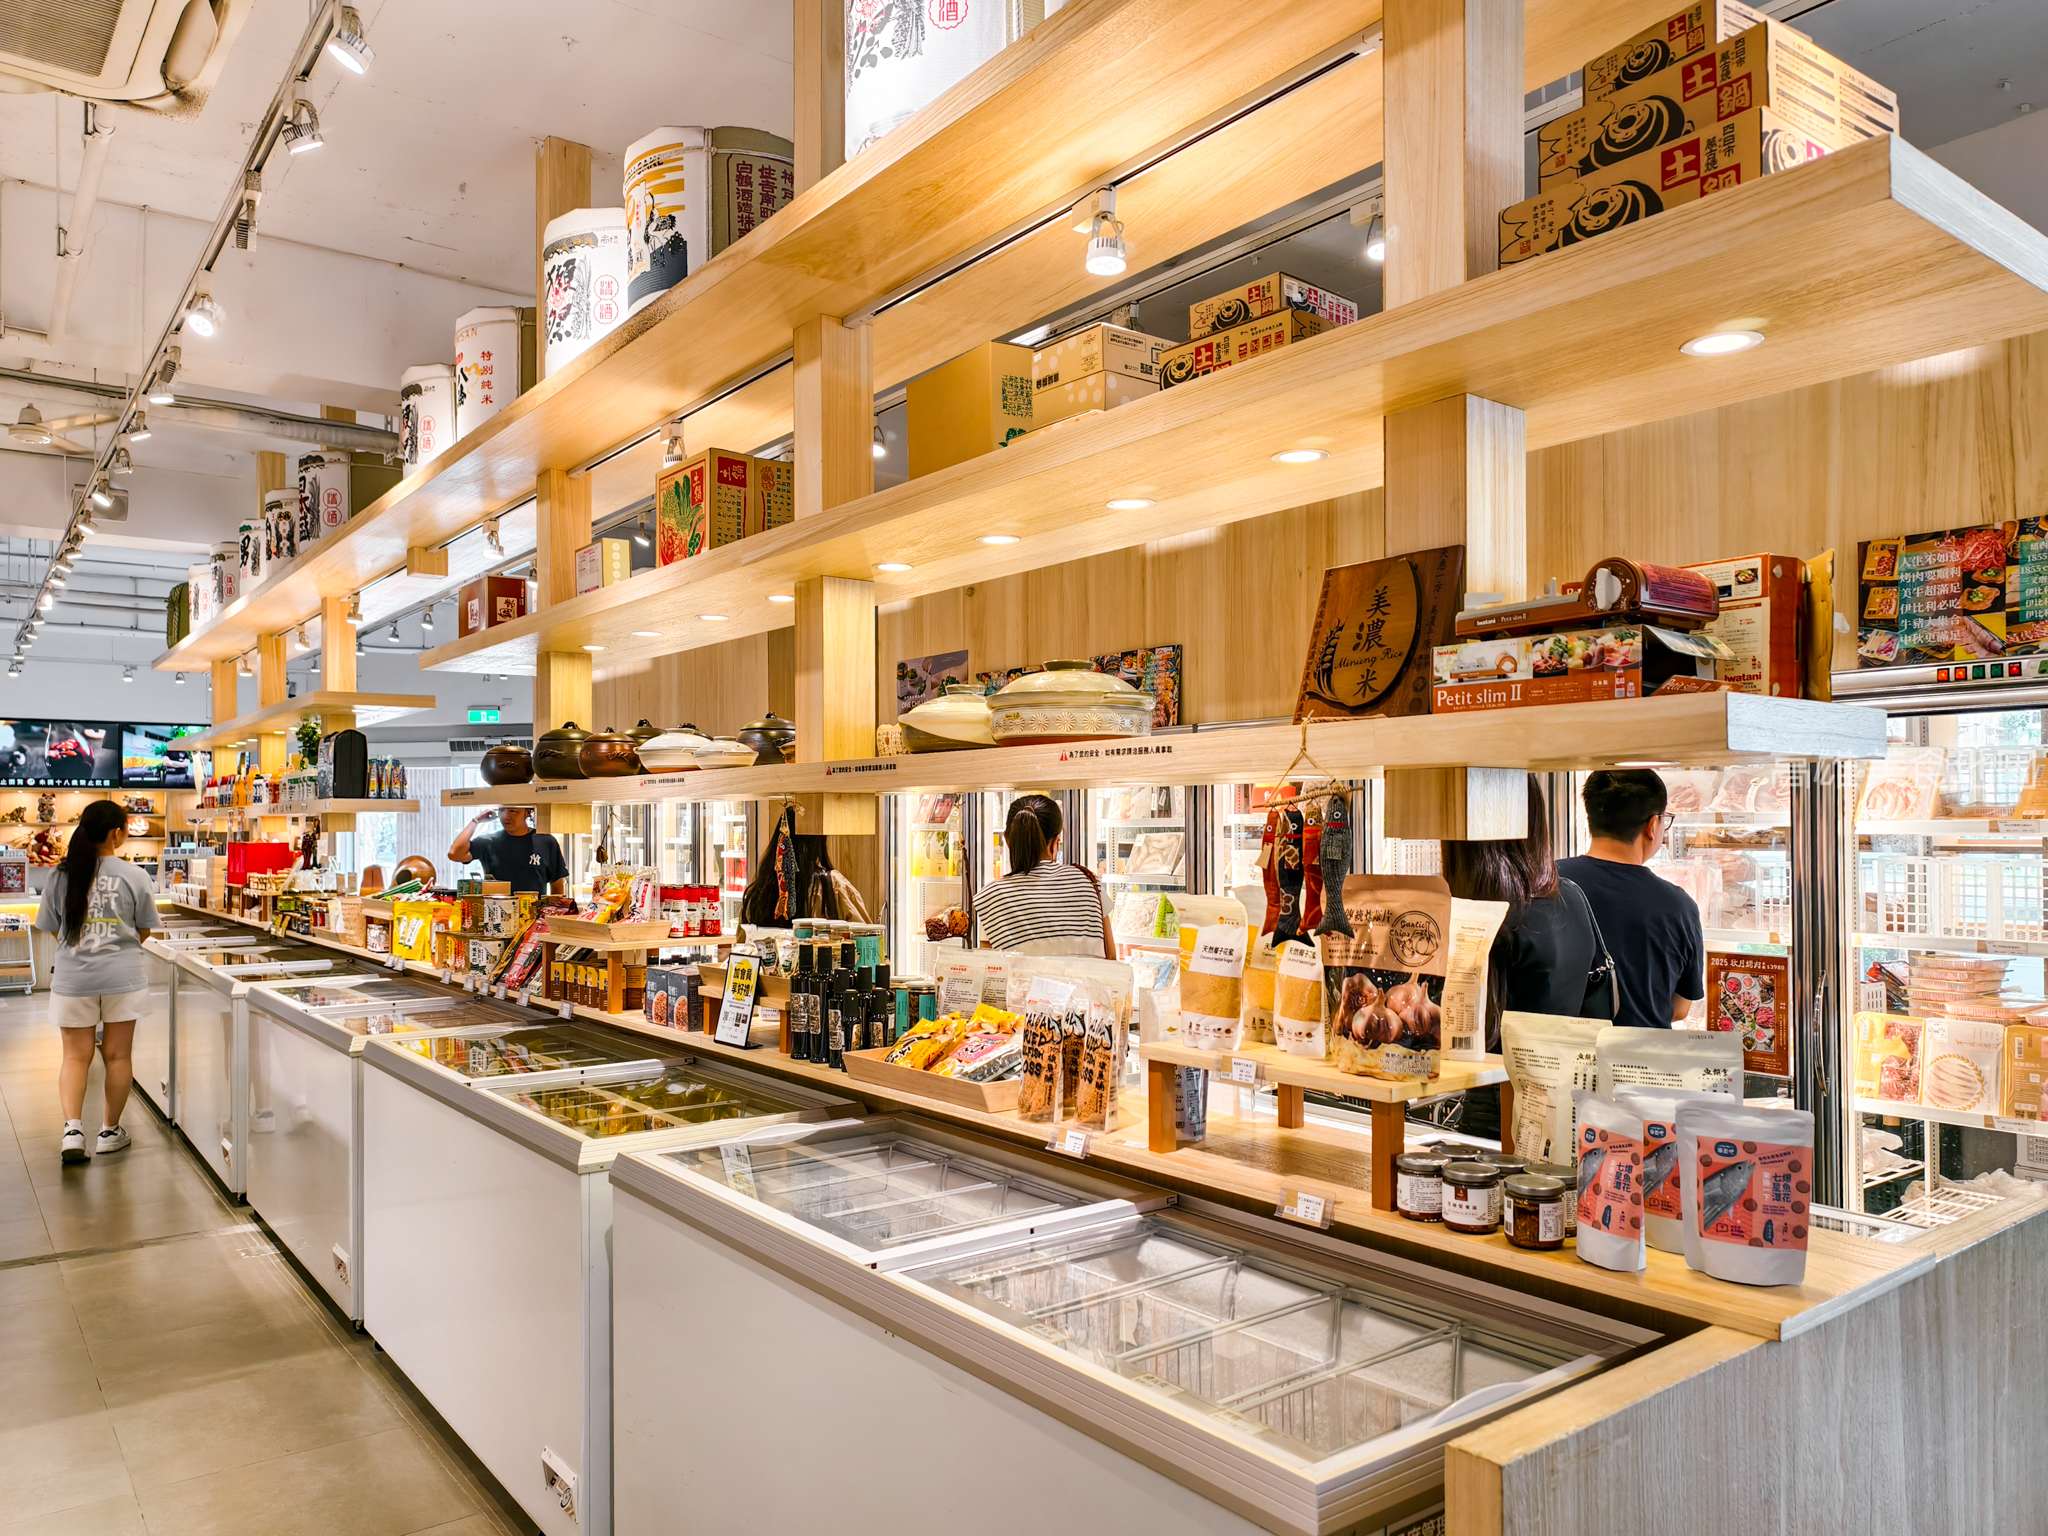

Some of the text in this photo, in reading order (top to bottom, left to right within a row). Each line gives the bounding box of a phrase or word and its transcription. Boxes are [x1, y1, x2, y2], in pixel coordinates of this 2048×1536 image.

[480, 350, 494, 405] 特別純米
[1381, 648, 1402, 662] Rice
[1353, 667, 1380, 699] 米
[1724, 671, 1762, 683] Iwatani
[1437, 690, 1473, 707] Petit
[1476, 688, 1507, 704] slim
[1510, 683, 1522, 701] II
[82, 922, 120, 938] RIDE
[1400, 920, 1425, 929] Garlic
[1390, 929, 1410, 938] Chips
[1022, 1060, 1042, 1078] OSS
